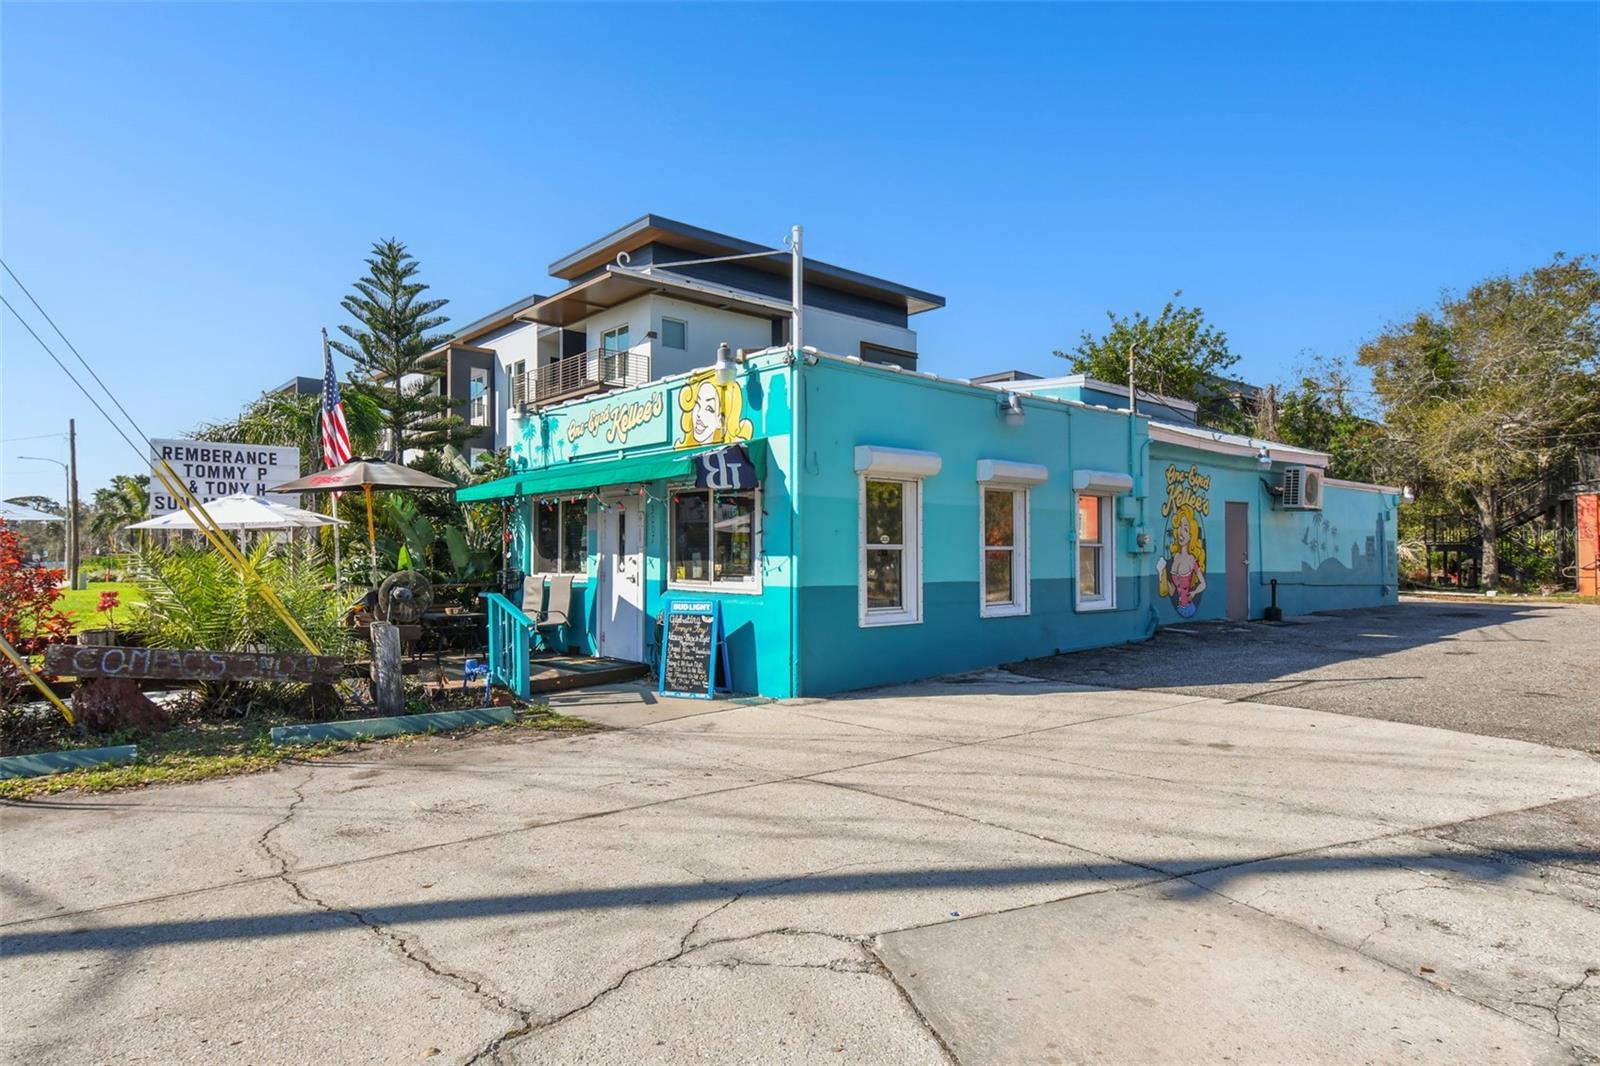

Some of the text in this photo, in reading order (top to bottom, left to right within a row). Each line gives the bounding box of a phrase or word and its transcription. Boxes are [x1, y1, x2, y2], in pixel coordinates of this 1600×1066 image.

[606, 391, 663, 445] Kellee's
[162, 446, 277, 466] REMBERANCE
[183, 463, 268, 481] TOMMY P
[1165, 463, 1210, 492] One-Eyed
[189, 480, 266, 497] & TONY H
[1162, 483, 1210, 517] Kellee's
[672, 603, 711, 611] BUD LIGHT
[72, 648, 227, 676] COMPACS
